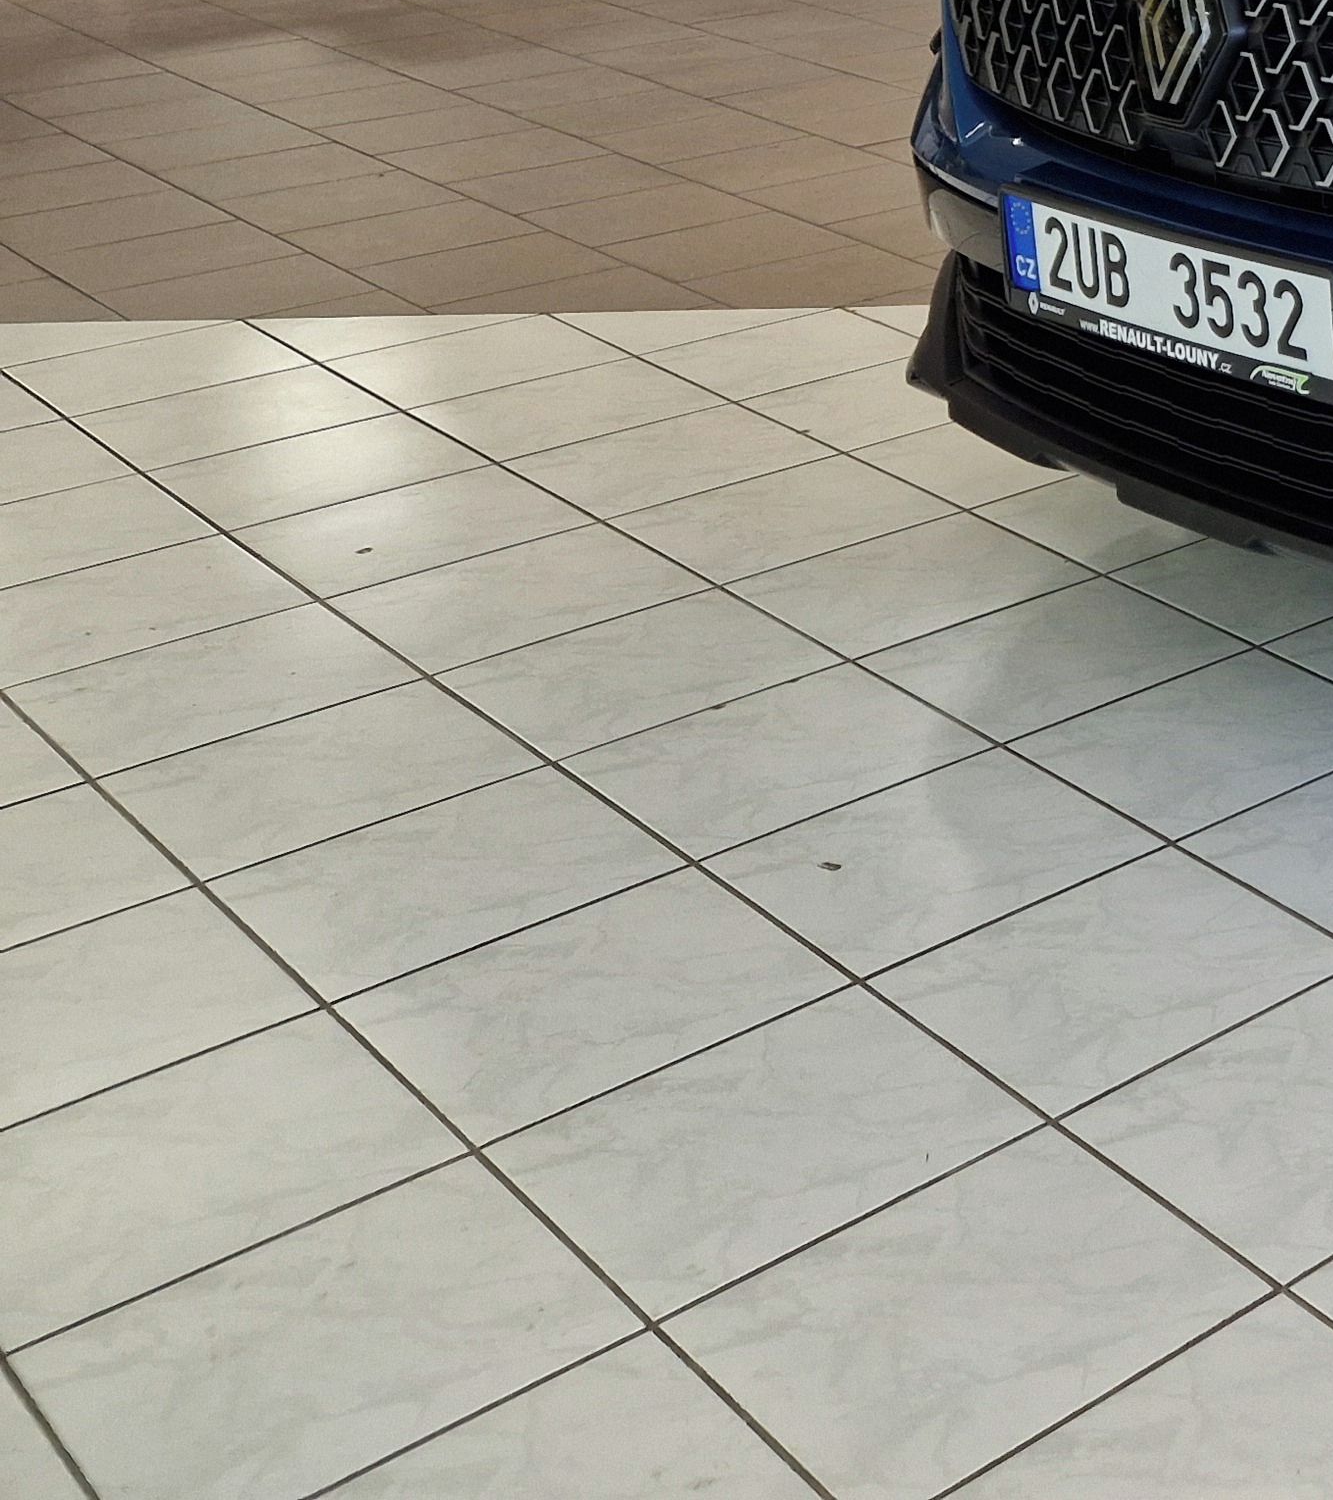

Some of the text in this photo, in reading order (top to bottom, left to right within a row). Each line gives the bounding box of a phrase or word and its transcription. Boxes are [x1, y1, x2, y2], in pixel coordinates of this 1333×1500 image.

[1015, 254, 1037, 280] CZ
[1044, 216, 1308, 362] 2UB 3532
[1079, 318, 1232, 374] www.RENAULT-LOUNY.cz
